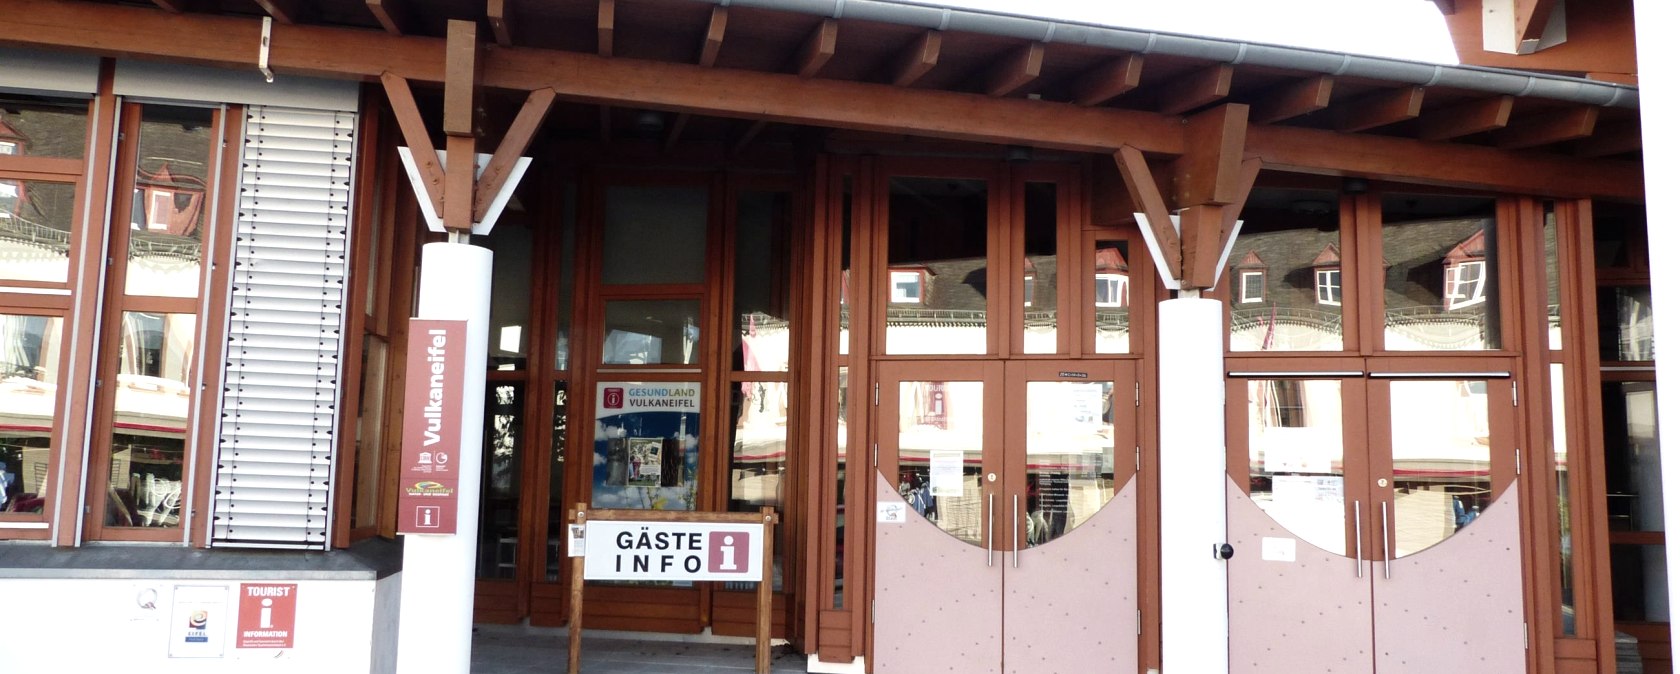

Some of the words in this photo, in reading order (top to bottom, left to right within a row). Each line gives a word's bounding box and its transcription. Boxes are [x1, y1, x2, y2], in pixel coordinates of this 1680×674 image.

[423, 329, 447, 447] Vulkaneifel
[628, 388, 696, 397] GESUNDLAND
[629, 399, 695, 408] VULKANEIFEL
[616, 526, 703, 551] GÄSTE
[615, 554, 702, 573] INFO
[246, 586, 291, 597] TOURIST
[243, 630, 288, 638] INFORMATION
